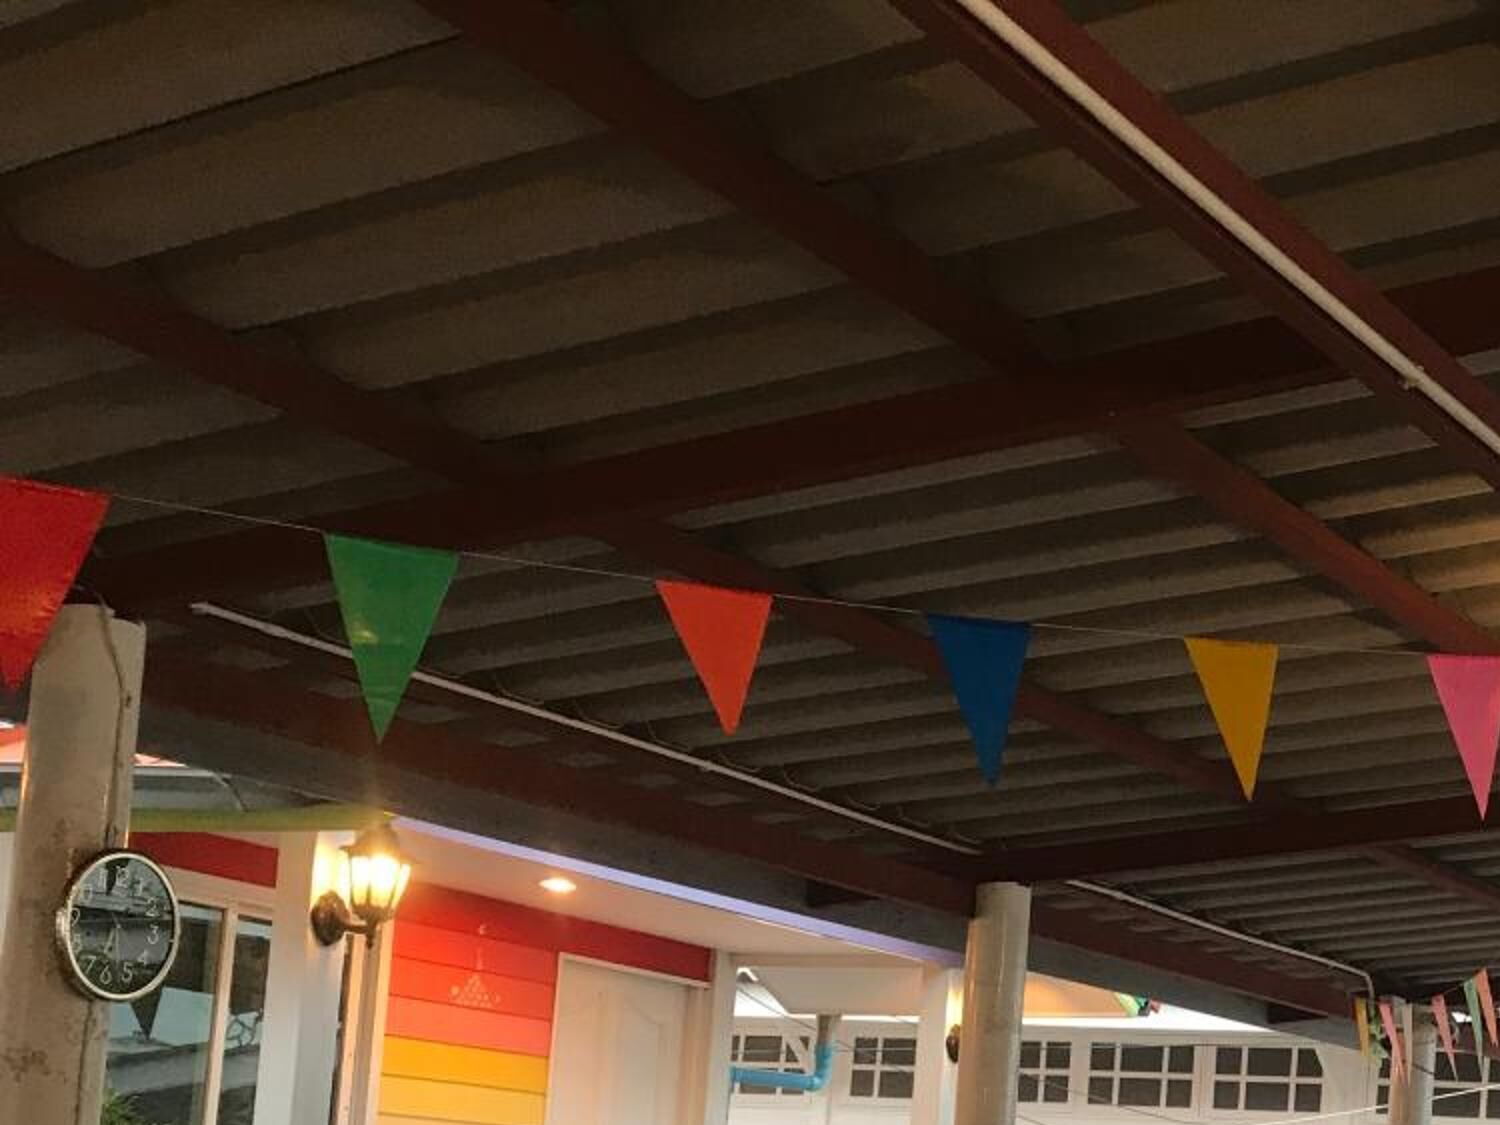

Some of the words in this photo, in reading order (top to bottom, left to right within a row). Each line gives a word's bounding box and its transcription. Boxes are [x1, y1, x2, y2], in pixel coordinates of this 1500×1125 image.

[145, 896, 160, 917] 2
[71, 908, 81, 927] 9
[147, 925, 160, 945] 3
[80, 955, 97, 974] 7
[137, 950, 149, 966] 4
[99, 965, 113, 985] 6
[121, 962, 134, 982] 5
